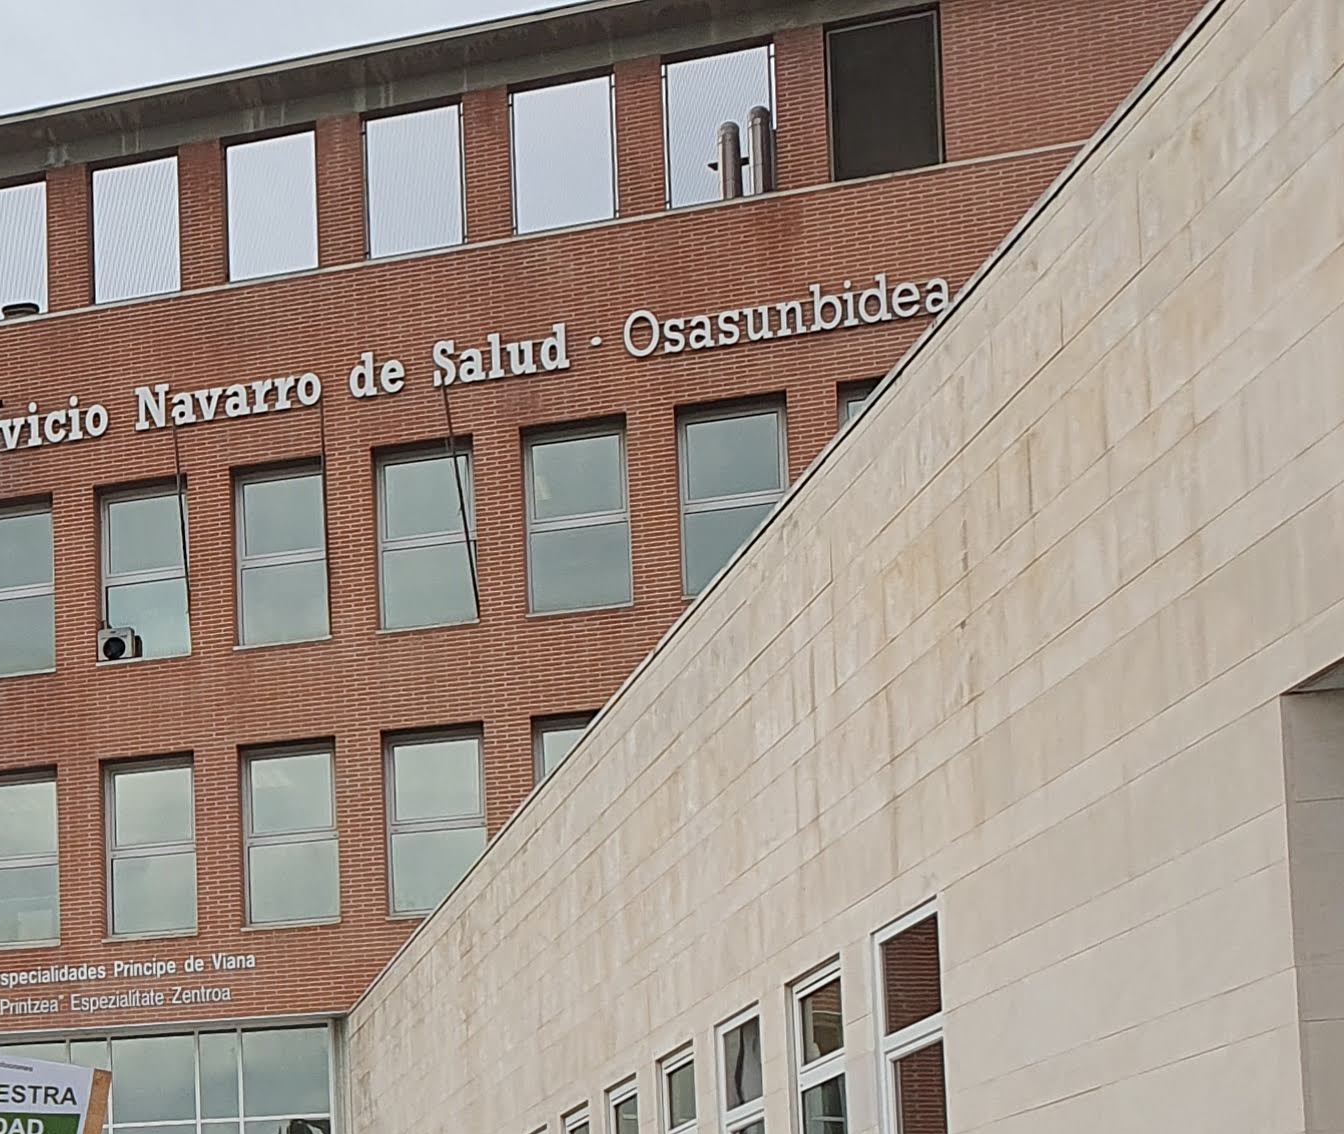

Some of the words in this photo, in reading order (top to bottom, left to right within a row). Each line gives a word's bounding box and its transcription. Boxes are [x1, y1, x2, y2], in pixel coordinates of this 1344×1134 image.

[134, 372, 322, 432] Navarro
[349, 351, 406, 398] de
[433, 323, 570, 387] Salud
[623, 274, 951, 358] Osasunbidea
[184, 955, 204, 972] de
[211, 952, 256, 970] Viana
[71, 989, 164, 1012] Espezialitate
[171, 984, 232, 1004] Zentroa
